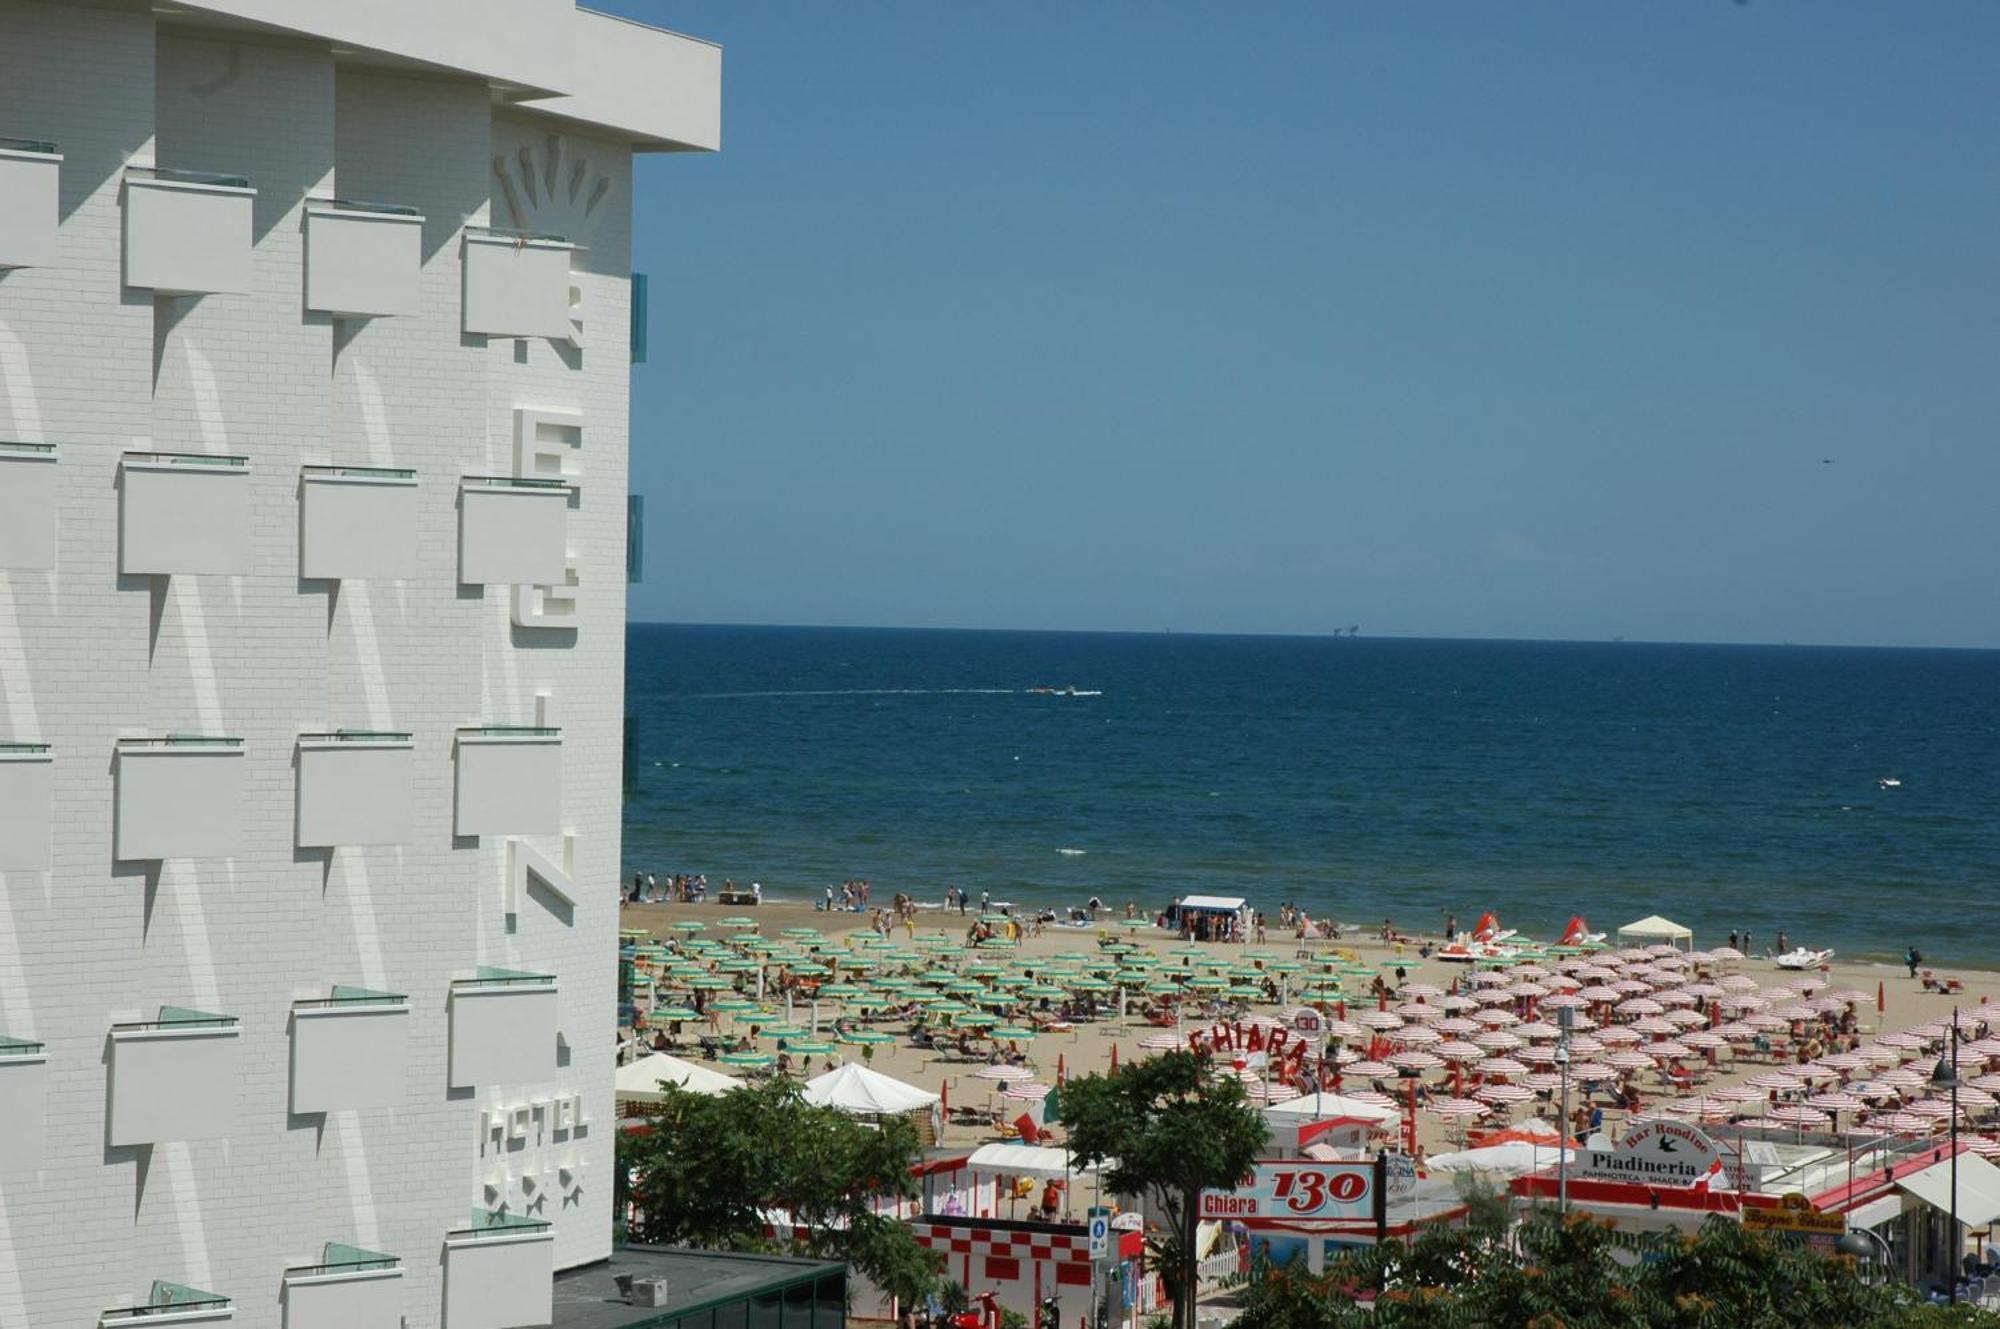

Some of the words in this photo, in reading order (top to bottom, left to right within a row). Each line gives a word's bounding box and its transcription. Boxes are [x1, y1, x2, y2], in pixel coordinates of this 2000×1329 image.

[480, 1093, 592, 1148] HOTEL
[1625, 1126, 1651, 1149] Bar
[1655, 1122, 1709, 1155] Rondine
[1582, 1170, 1641, 1182] PANINOTECA
[1592, 1153, 1697, 1177] Piadineria
[1204, 1194, 1258, 1214] Chiara
[1271, 1170, 1369, 1215] 130
